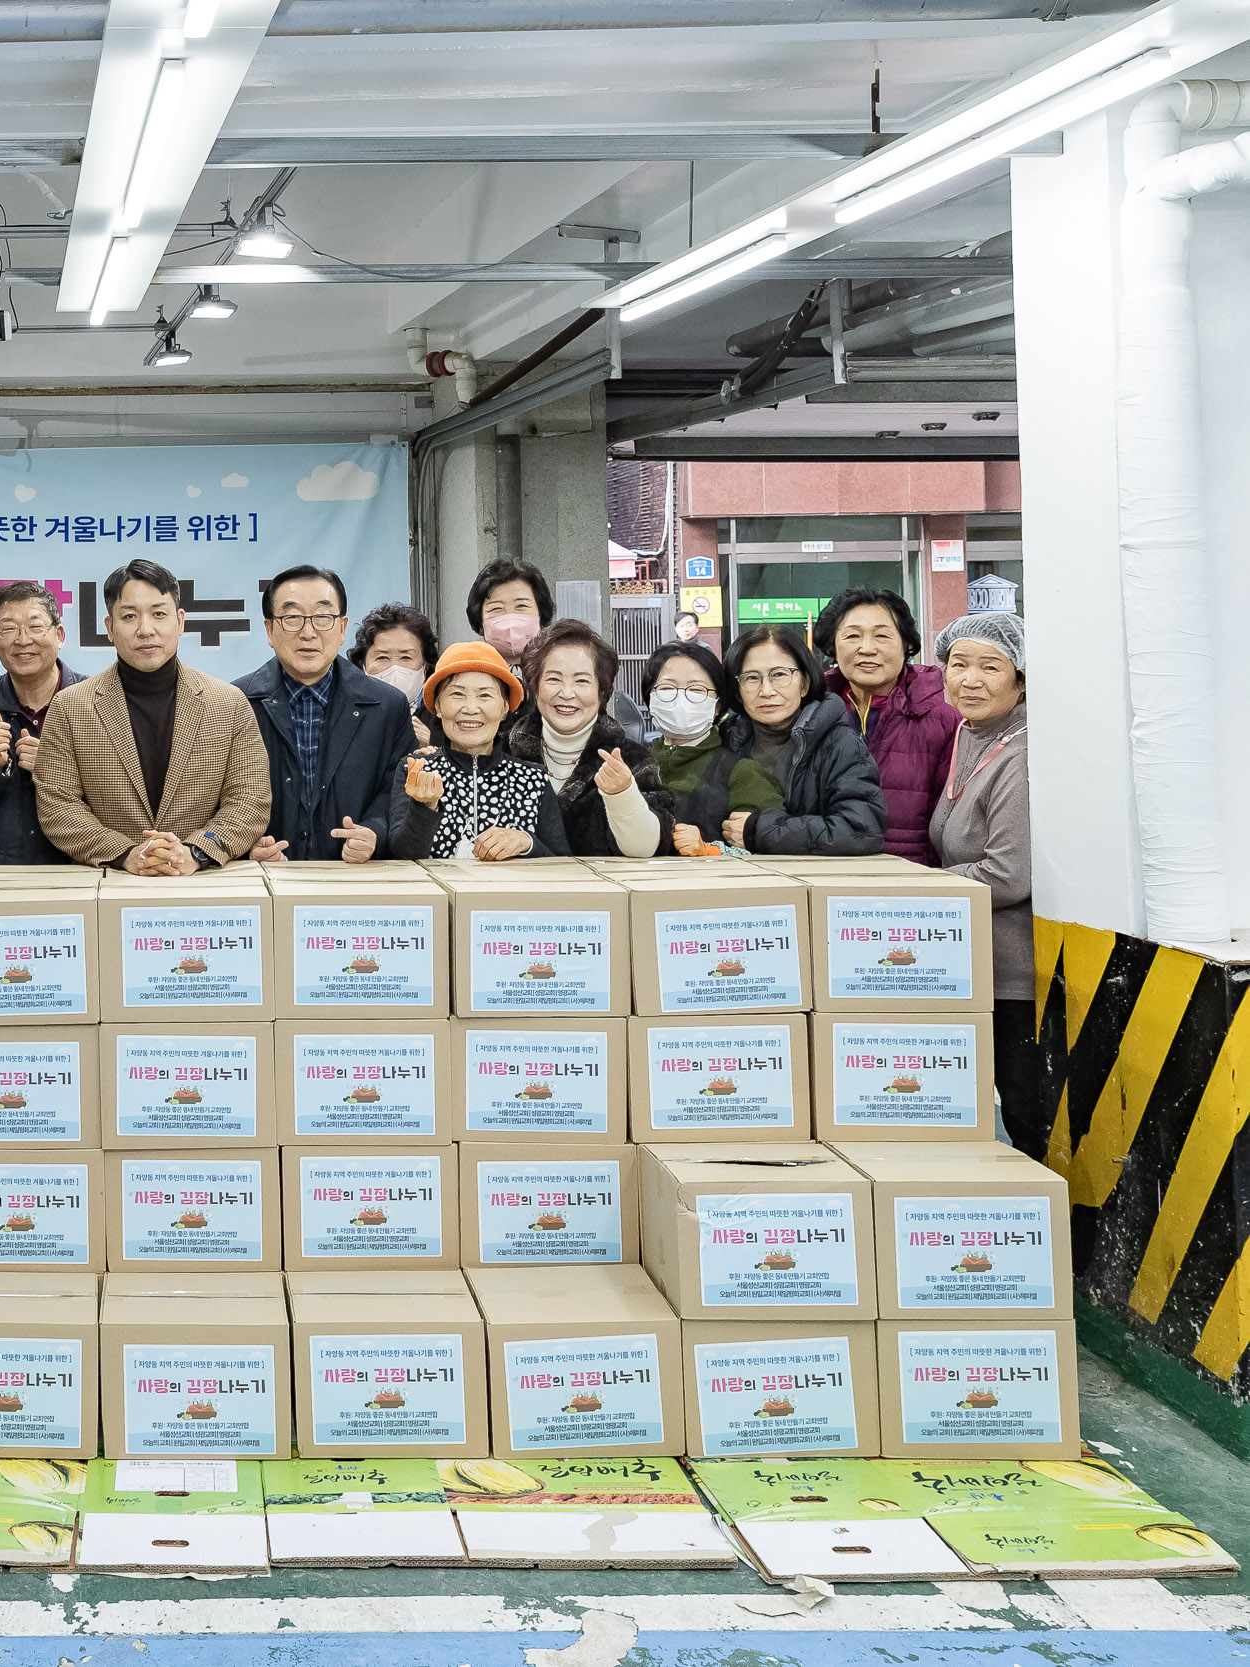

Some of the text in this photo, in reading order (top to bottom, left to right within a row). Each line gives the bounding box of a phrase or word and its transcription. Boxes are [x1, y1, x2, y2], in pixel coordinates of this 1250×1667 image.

[44, 515, 179, 543] 겨울나기를
[186, 514, 240, 542] 위한
[695, 568, 706, 576] 14
[776, 603, 802, 611] 피아노
[840, 928, 962, 941] 사랑의 김장나누기
[134, 936, 252, 950] 사랑의 김장나누기
[306, 936, 424, 949] 사랑의 김장나누기
[483, 942, 601, 955] 사랑의 김장나누기
[669, 936, 789, 955] 사랑의 김장나누기
[4, 944, 76, 960] 김장나누기
[478, 1061, 598, 1076] 사랑의 김장나누기
[661, 1056, 782, 1072] 사랑의 김장나누기
[845, 1054, 967, 1069] 사랑의 김장나누기
[129, 1066, 247, 1080] 사랑의 김장나누기
[306, 1065, 425, 1079] 사랑의 김장나누기
[7, 1195, 79, 1207] 김장나누기
[134, 1191, 252, 1204] 사랑의 김장나누기
[313, 1187, 432, 1201] 사랑의 김장나누기
[490, 1192, 611, 1206] 사랑의 김장나누기
[712, 1228, 845, 1244] 사랑의 김장나누기
[909, 1230, 1042, 1246] 사랑의 김장나누기
[324, 1367, 454, 1383] 사랑의 김장나누기
[519, 1368, 650, 1389] 사랑의 김장나누기
[913, 1366, 1048, 1381] 사랑의 김장나누기
[137, 1379, 265, 1393] 사랑의 김장나누기
[710, 1371, 842, 1393] 사랑의 김장나누기
